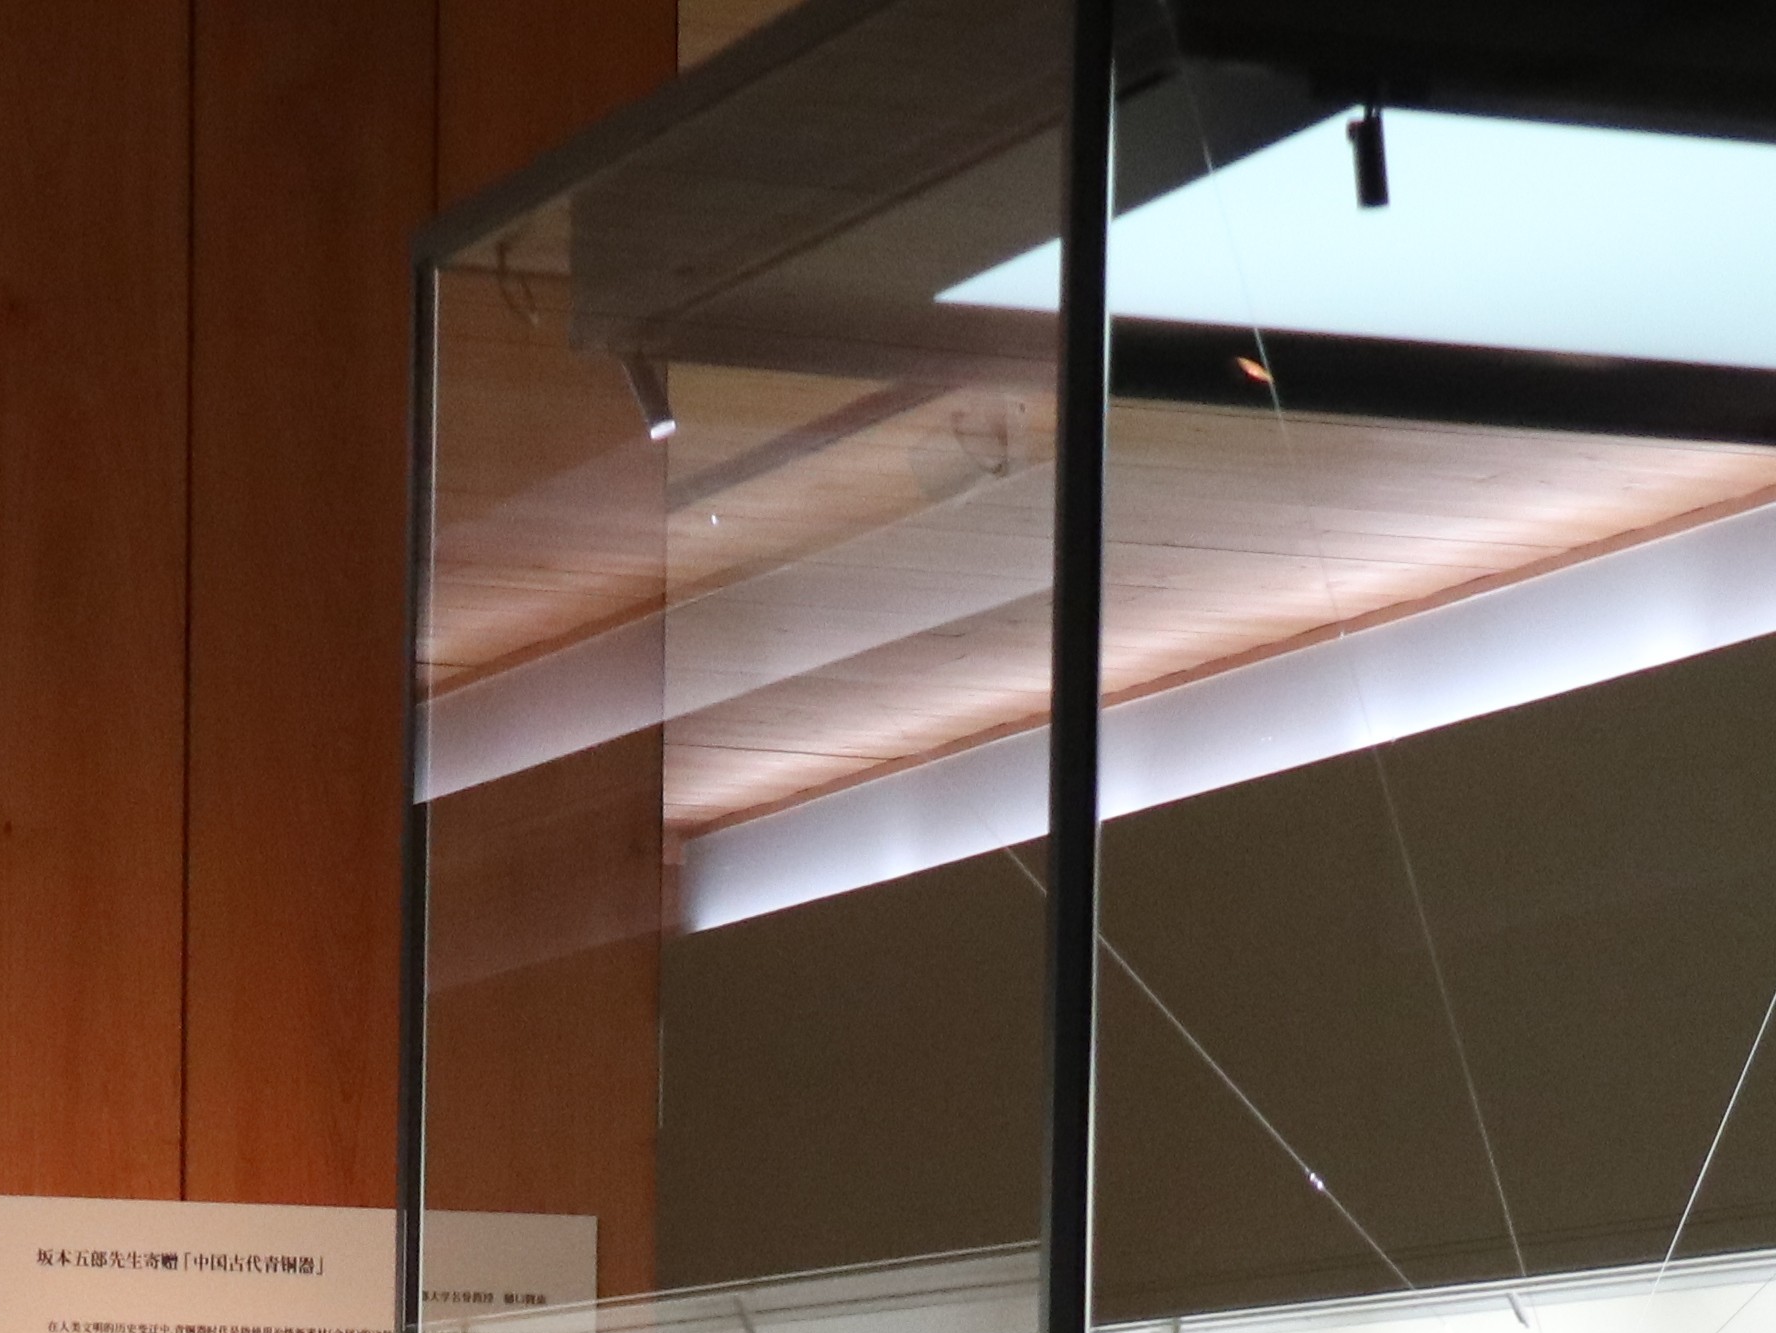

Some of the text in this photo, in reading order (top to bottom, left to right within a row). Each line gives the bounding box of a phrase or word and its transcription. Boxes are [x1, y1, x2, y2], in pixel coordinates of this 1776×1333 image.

[36, 1248, 325, 1276] 坂本五郎先生寄赠「中国古代青铜器」
